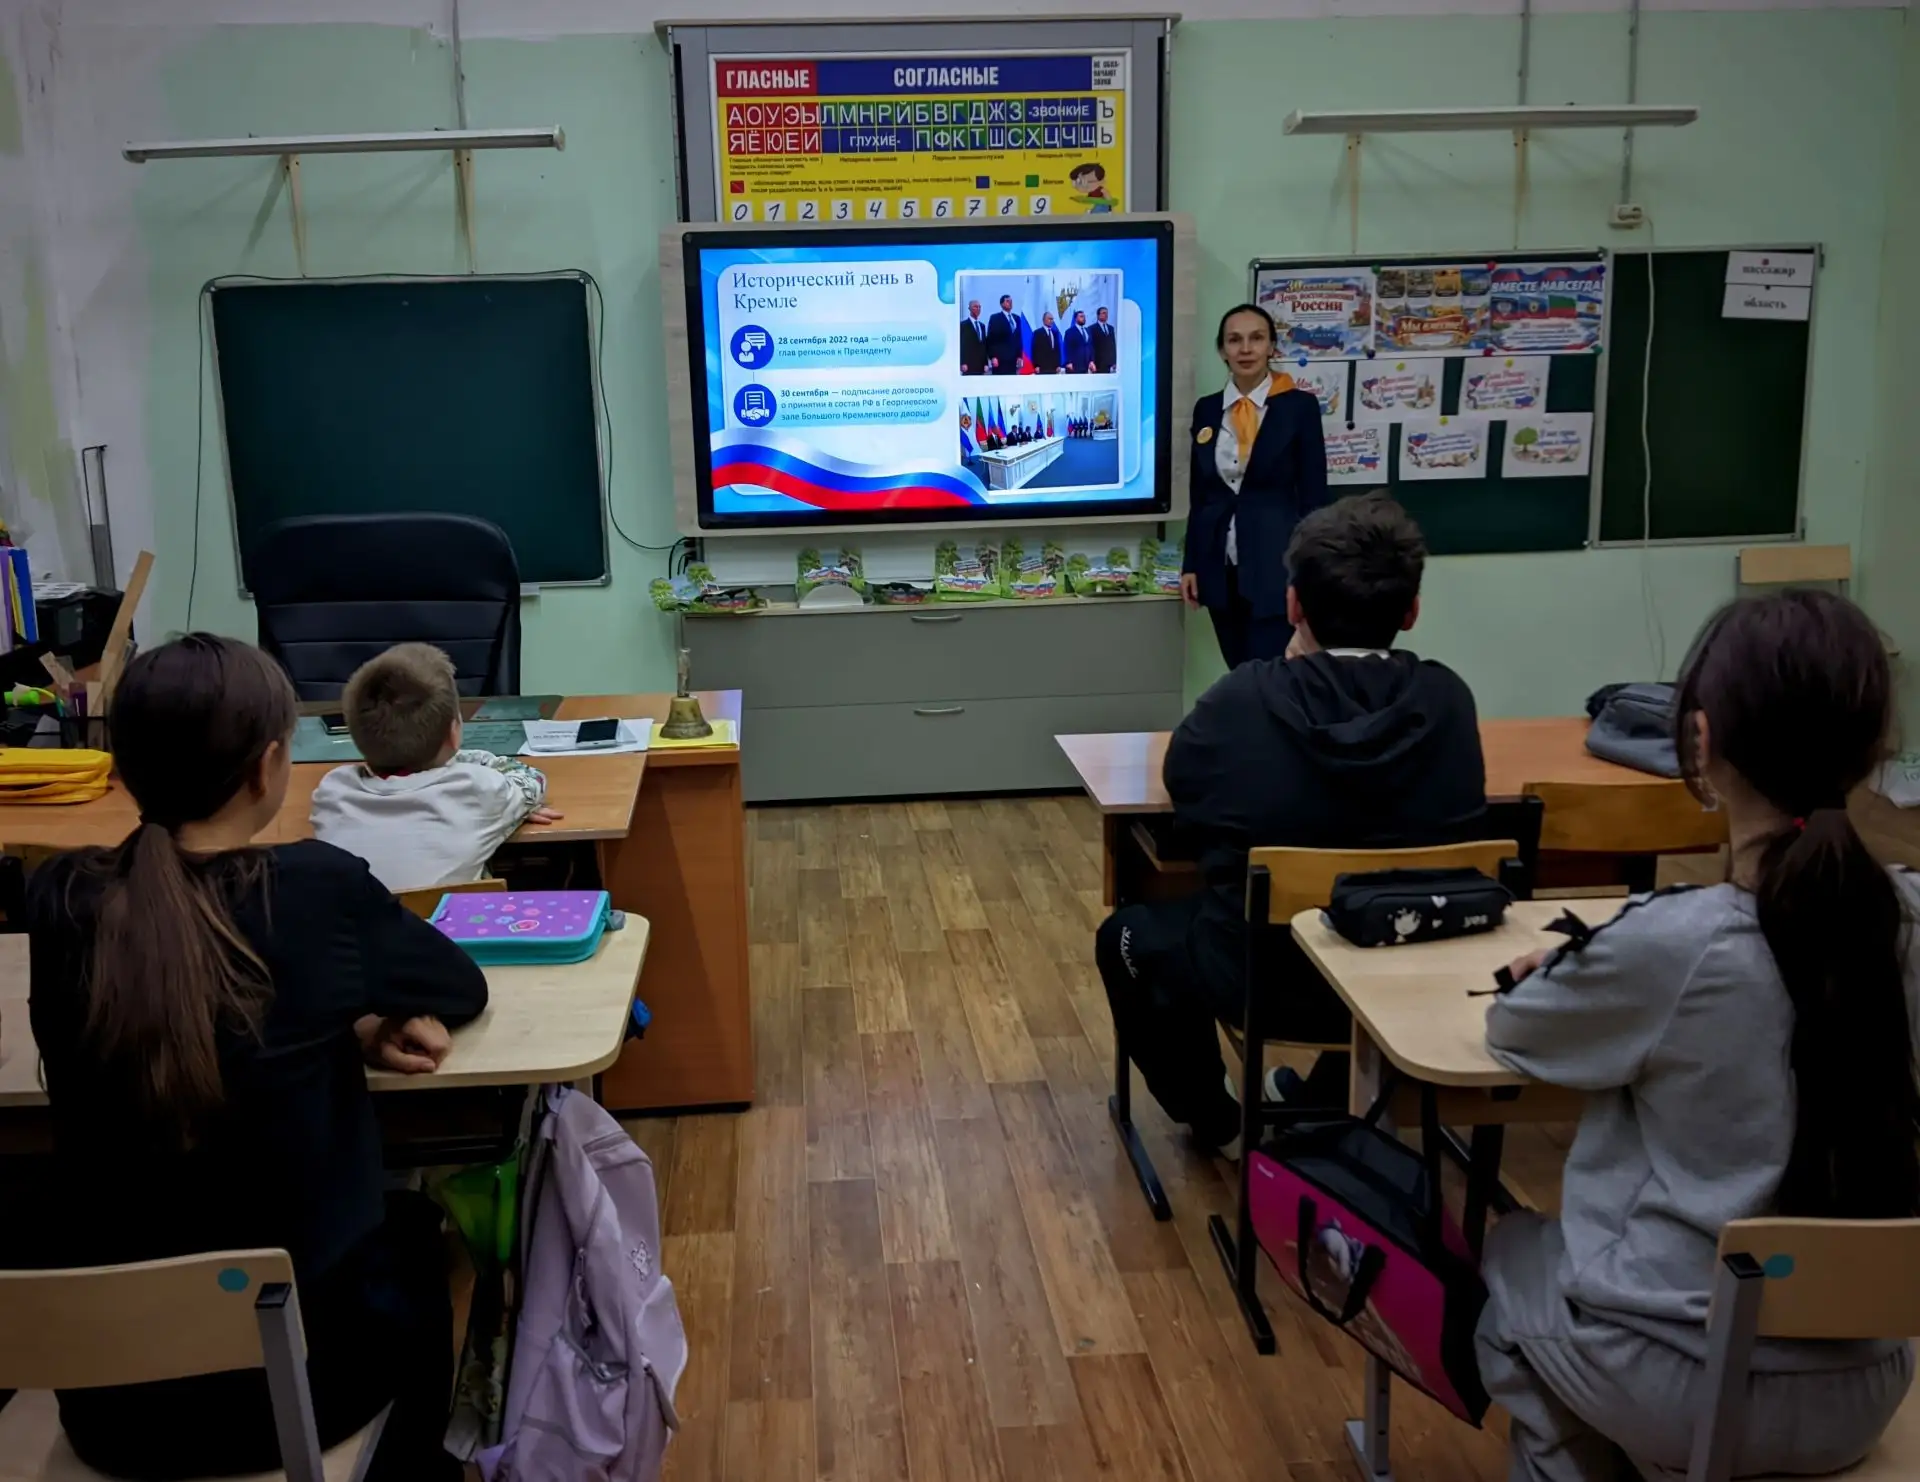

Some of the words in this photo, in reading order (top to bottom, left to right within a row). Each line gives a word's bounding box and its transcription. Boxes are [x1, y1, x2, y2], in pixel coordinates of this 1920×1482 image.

[726, 69, 810, 89] ГЛАСНЫЕ
[893, 66, 999, 88] СОГЛАСНЫЕ
[734, 203, 748, 220] 0
[768, 203, 781, 220] 1
[802, 202, 815, 219] 2
[836, 202, 848, 219] 3
[869, 201, 882, 218] 4
[902, 200, 915, 217] 5
[935, 200, 948, 217] 6
[968, 199, 981, 216] 7
[1001, 198, 1014, 215] 8
[1034, 197, 1047, 214] 9
[733, 271, 855, 291] Исторический
[860, 273, 899, 288] день
[905, 273, 914, 284] в
[1491, 281, 1538, 293] ВМЕСТЕ
[734, 293, 798, 312] Кремле
[778, 337, 788, 345] 28
[790, 336, 827, 347] сентября
[829, 335, 848, 344] 2022
[850, 336, 869, 345] года
[881, 334, 928, 343] обращение
[778, 350, 796, 358] глав
[798, 349, 836, 358] регионов
[844, 347, 892, 356] Президенту
[781, 389, 790, 398] 30
[792, 388, 829, 398] сентября
[841, 388, 890, 397] подписание
[891, 386, 934, 395] договоров
[788, 401, 827, 410] принятии
[862, 399, 873, 407] РФ
[882, 398, 938, 407] Георгиевском
[801, 412, 840, 420] Большого
[900, 410, 930, 419] дворца
